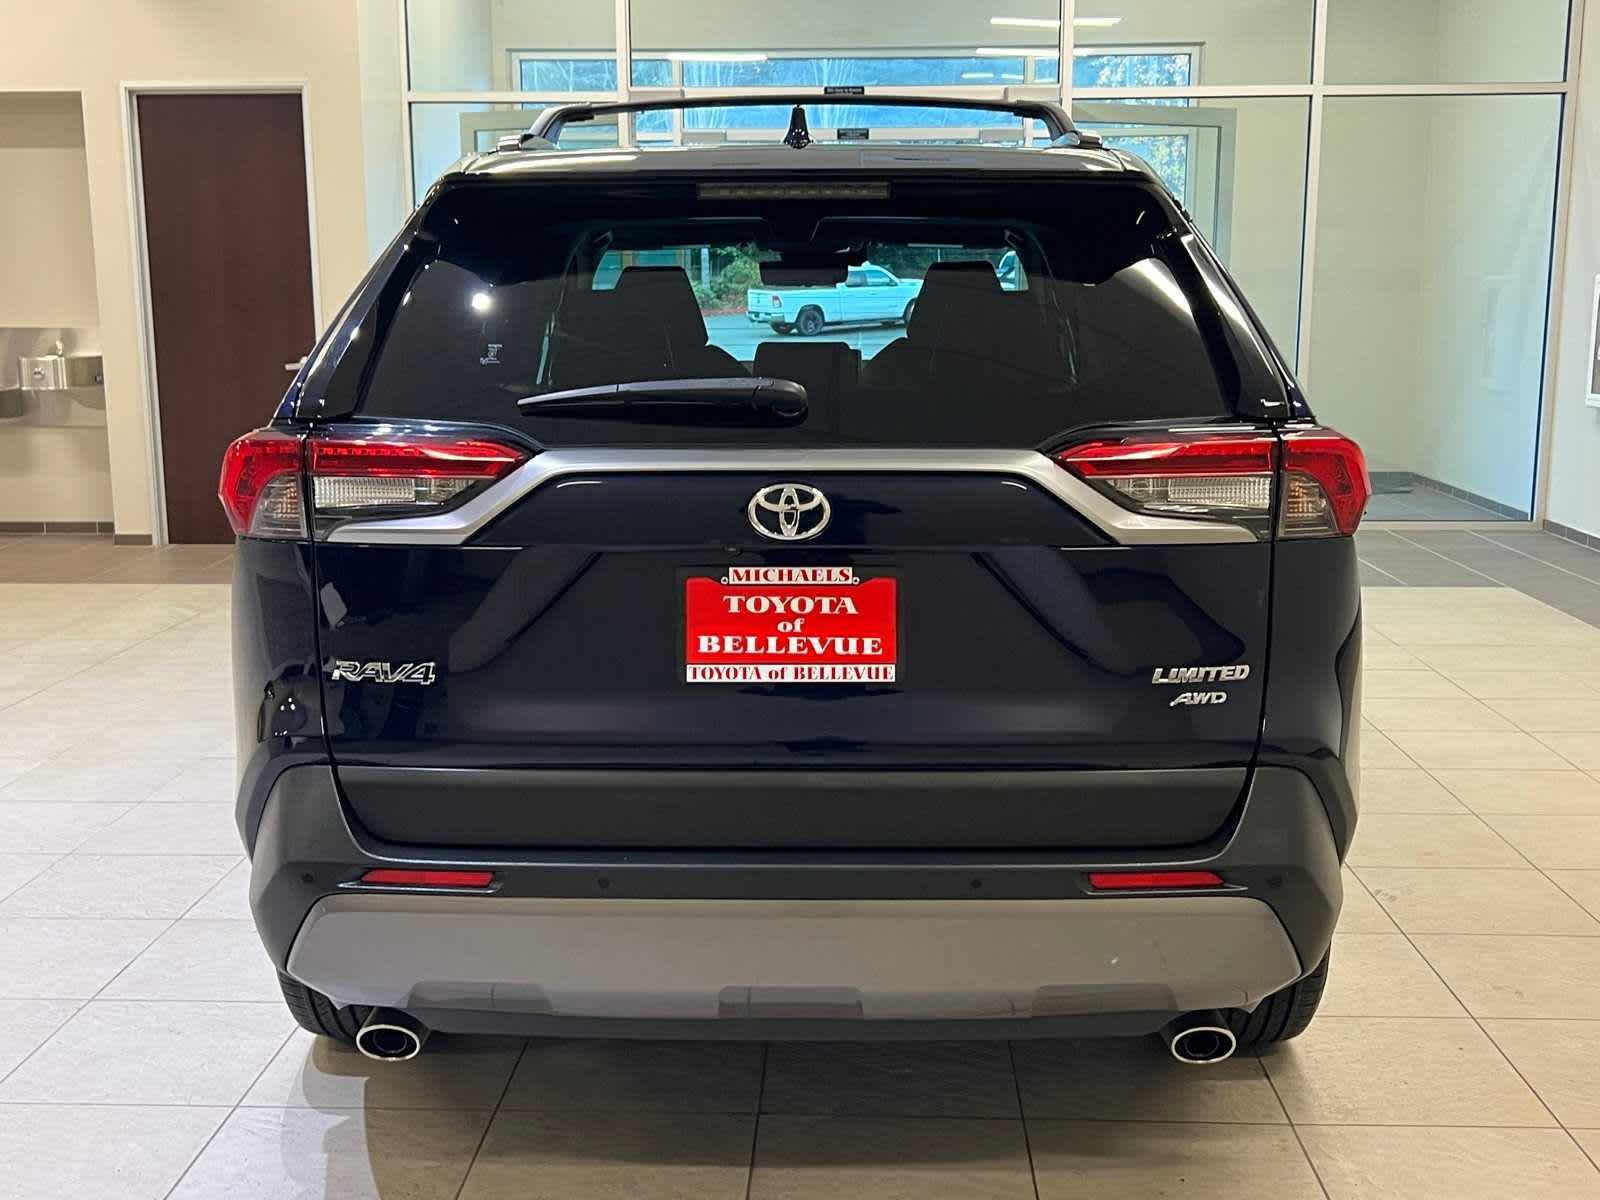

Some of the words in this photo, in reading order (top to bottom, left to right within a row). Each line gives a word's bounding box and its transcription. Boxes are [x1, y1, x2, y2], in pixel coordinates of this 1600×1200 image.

[731, 568, 850, 582] MICHAELS
[723, 595, 858, 614] TOYOTA
[777, 617, 805, 633] of
[697, 635, 883, 655] BELLEVUE
[331, 660, 436, 685] RAV4
[688, 666, 761, 680] TOYOTA
[768, 666, 788, 680] of
[793, 666, 894, 681] BELLEVUE
[1151, 664, 1250, 684] LIMITED
[1169, 691, 1227, 707] AWD
